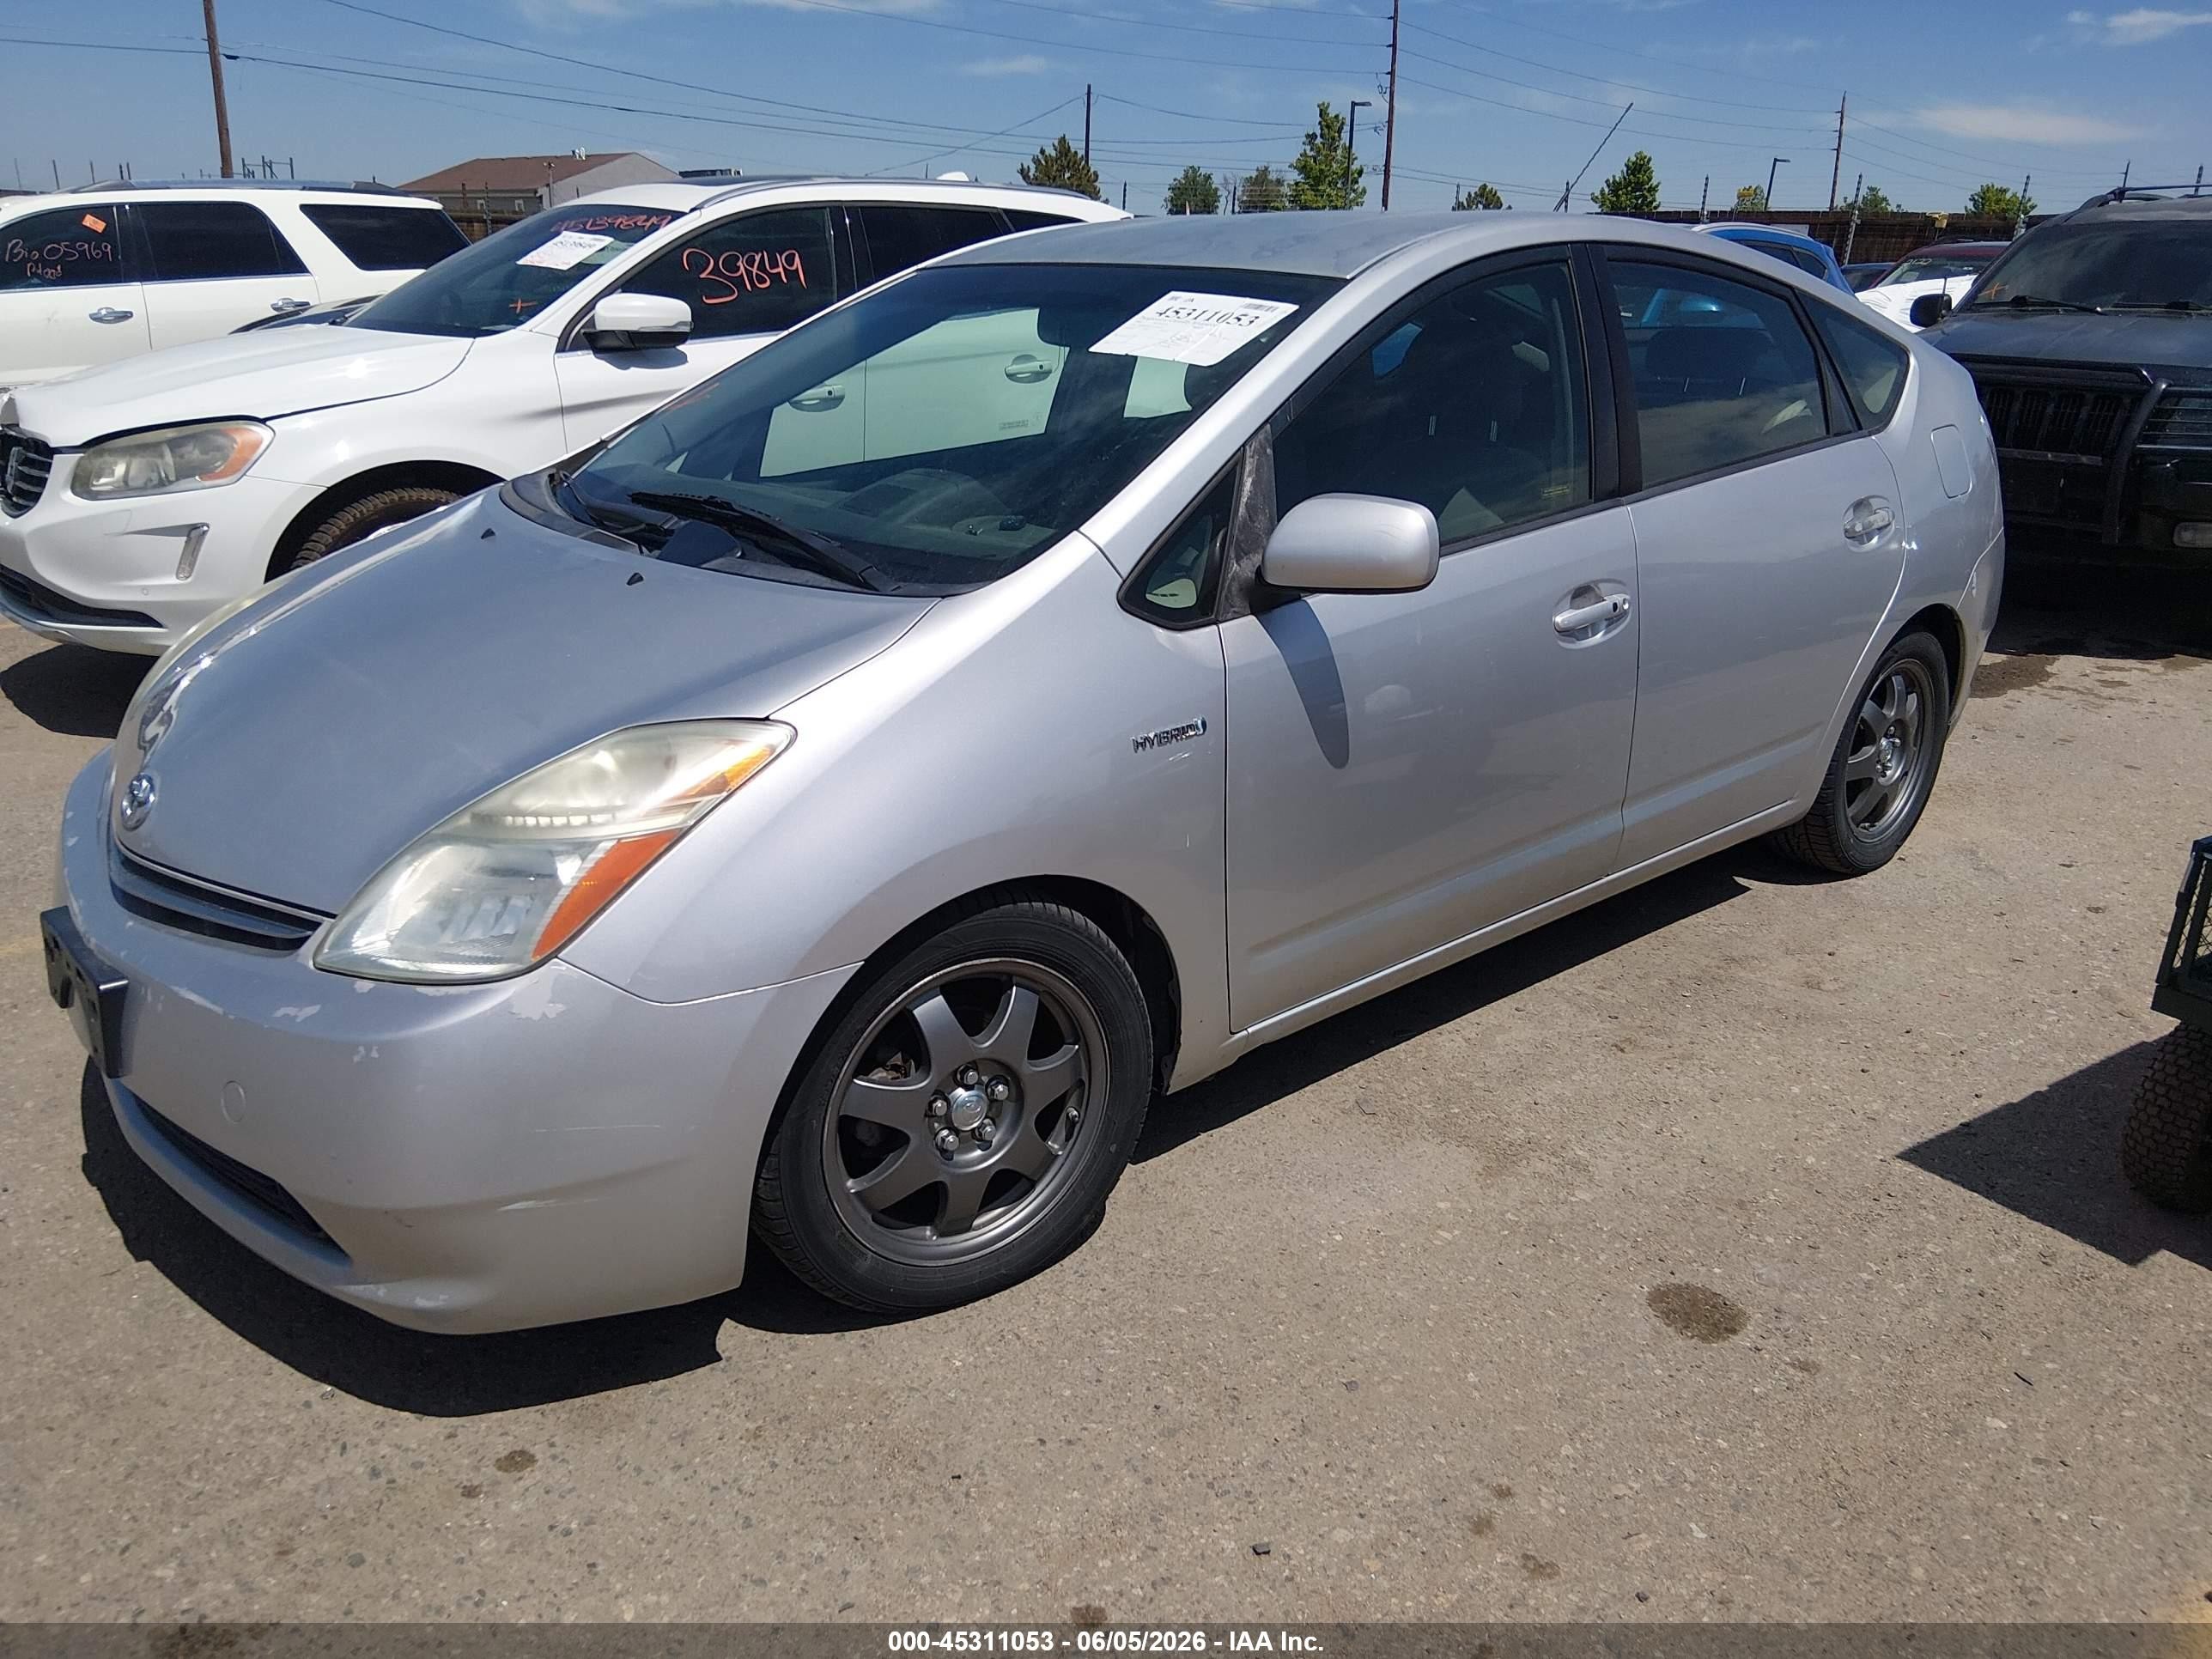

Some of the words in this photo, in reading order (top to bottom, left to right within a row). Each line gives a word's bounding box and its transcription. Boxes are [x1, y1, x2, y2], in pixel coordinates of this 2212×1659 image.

[43, 241, 112, 262] 05969
[683, 247, 808, 304] 39849
[1155, 306, 1261, 327] 45311053
[1131, 721, 1198, 754] HYBRID
